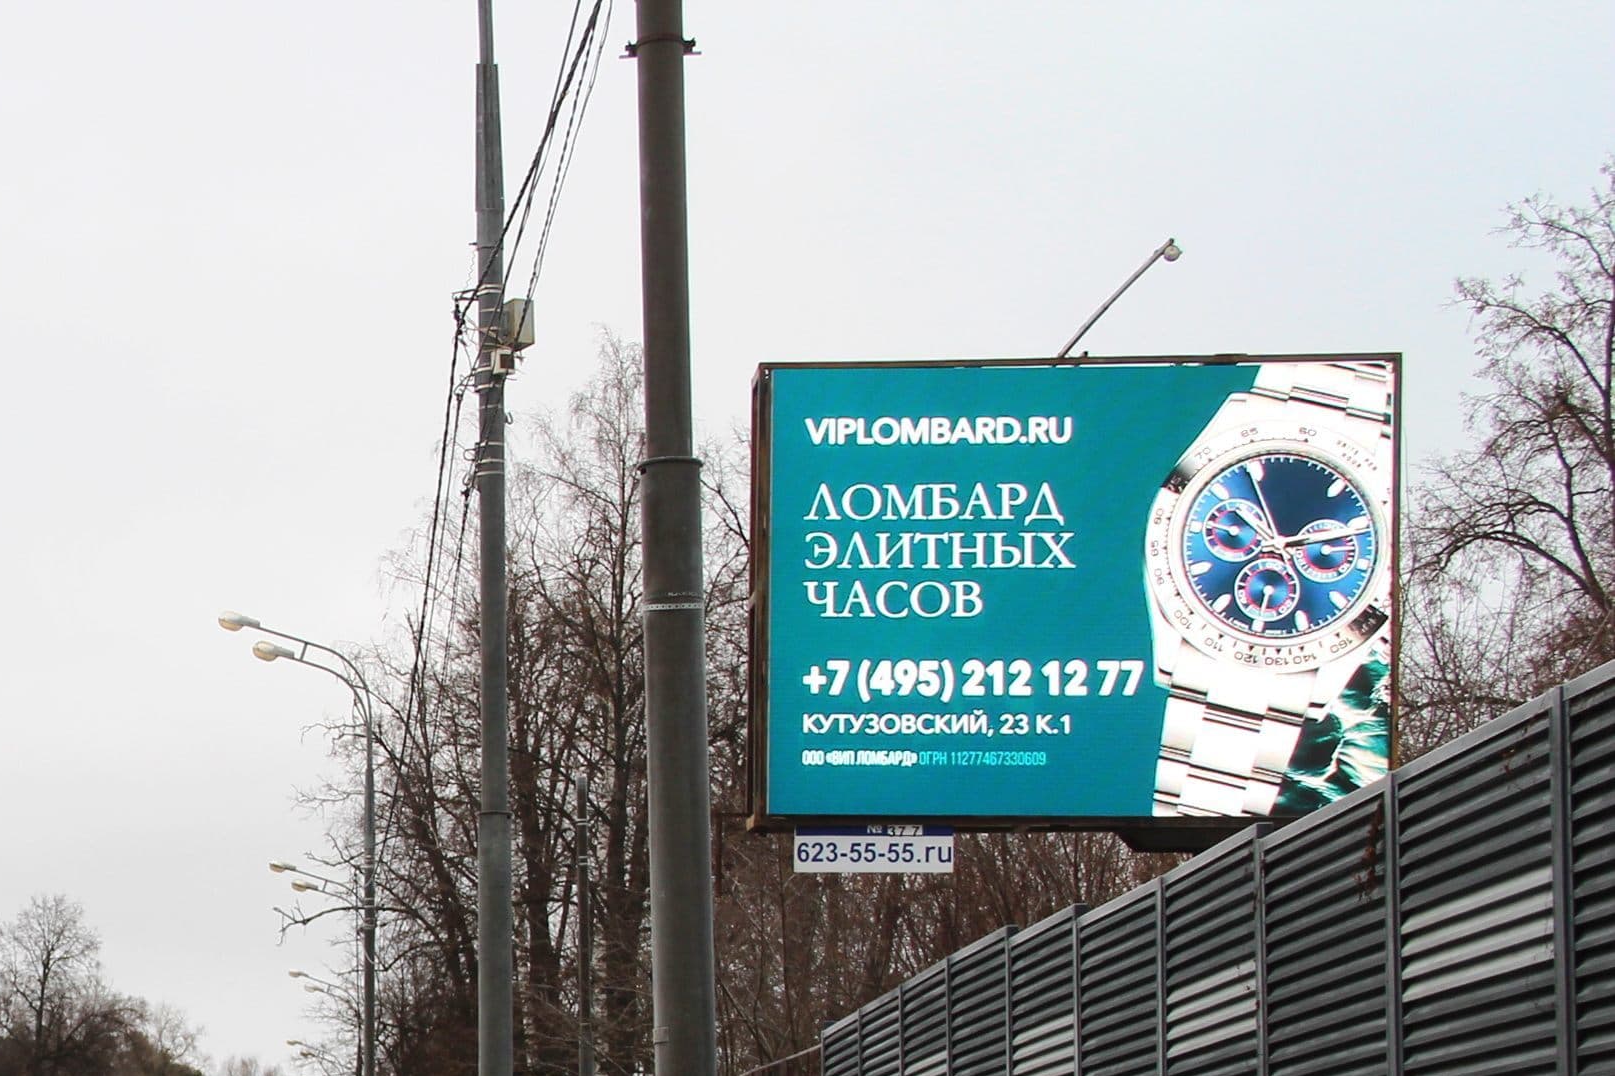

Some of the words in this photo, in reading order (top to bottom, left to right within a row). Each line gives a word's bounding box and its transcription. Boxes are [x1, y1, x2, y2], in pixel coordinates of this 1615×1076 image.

[804, 416, 1073, 446] VIPLOMBARD.RU
[802, 482, 1066, 526] ЛОМБАРД
[803, 531, 1077, 569] ЭЛИТНЫХ
[802, 580, 985, 618] ЧАСОВ
[802, 659, 851, 697] +7
[857, 659, 955, 703] (495)
[961, 659, 1033, 697] 212
[1041, 659, 1088, 697] 12
[1097, 659, 1144, 697] 77
[802, 709, 994, 738] КУТУЗОВСКИЙ,
[999, 714, 1030, 734] 23
[1036, 714, 1071, 734] К.1
[802, 750, 825, 766] ООО
[919, 751, 947, 766] ОГРН
[866, 824, 884, 835] №
[796, 842, 953, 863] 623-55-55.ru
